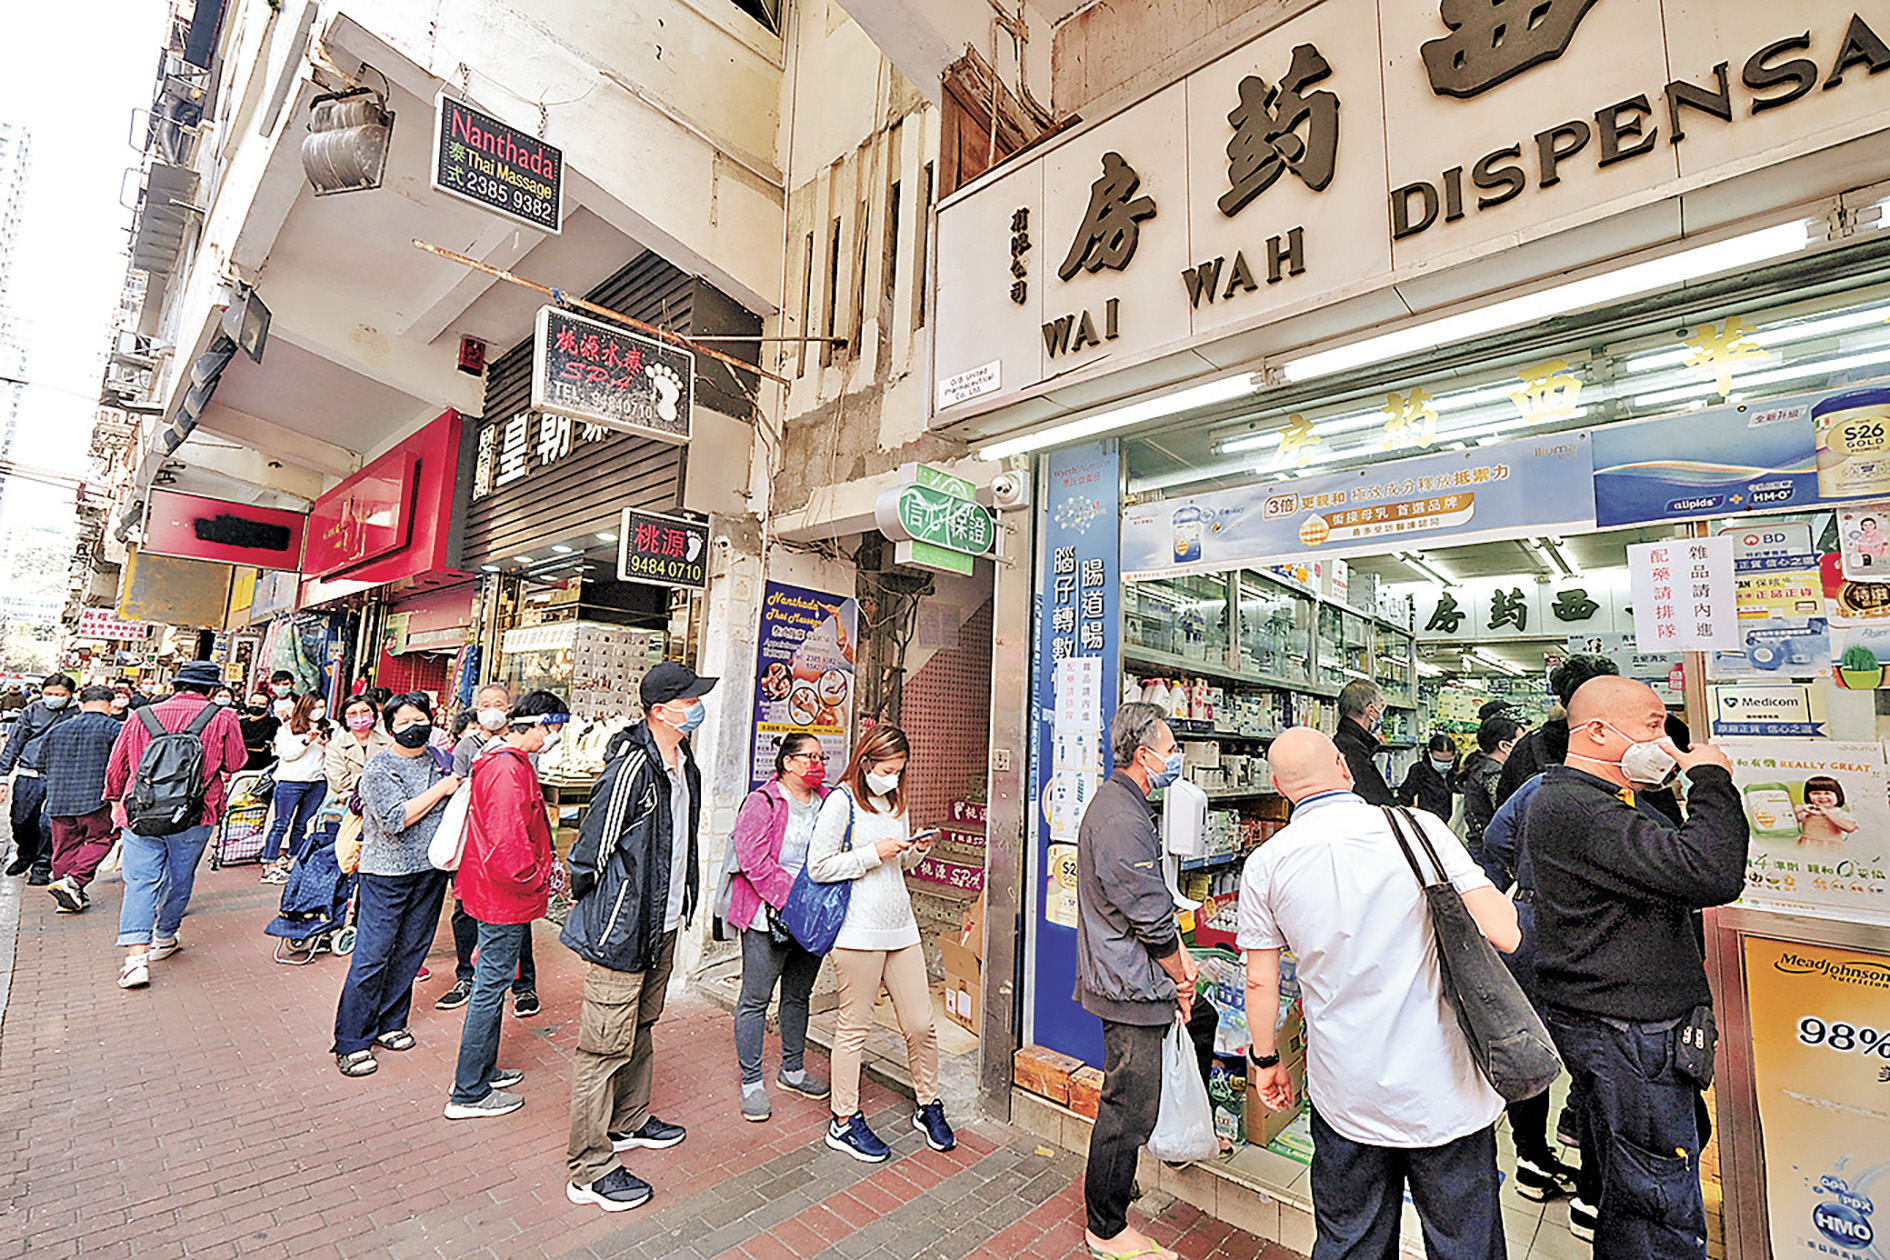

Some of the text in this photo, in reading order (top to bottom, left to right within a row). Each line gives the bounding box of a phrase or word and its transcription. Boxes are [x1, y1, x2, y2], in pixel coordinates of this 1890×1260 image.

[451, 108, 554, 180] Nanthada
[447, 141, 465, 187] 泰式
[466, 148, 552, 200] Thai Massage
[467, 172, 552, 220] 2385 9382
[1009, 206, 1032, 305] 有限公司
[1181, 226, 1306, 309] WAH
[1042, 298, 1120, 359] WAI
[591, 390, 653, 418] 94840710
[1846, 438, 1884, 448] GOLD
[1268, 499, 1295, 515] 3倍
[1302, 491, 1345, 510] 更親和
[1397, 496, 1458, 516] 首選品牌
[634, 522, 686, 558] 桃源
[1763, 533, 1786, 544] BD
[631, 555, 701, 581] 9484 0710
[767, 591, 819, 611] Nanthada
[1650, 548, 1676, 638] 配藥請排隊
[1689, 545, 1713, 637] 雜品請內進
[766, 608, 788, 620] Thai
[1082, 559, 1104, 657] 腸道暢
[1742, 697, 1799, 707] Medicom
[1780, 760, 1825, 770] REALLY
[1830, 761, 1873, 773] GREAT
[1830, 974, 1889, 989] Nutrition
[1799, 1018, 1890, 1058] 98%
[1843, 1196, 1873, 1213] PDX
[1817, 1212, 1872, 1241] HMO
